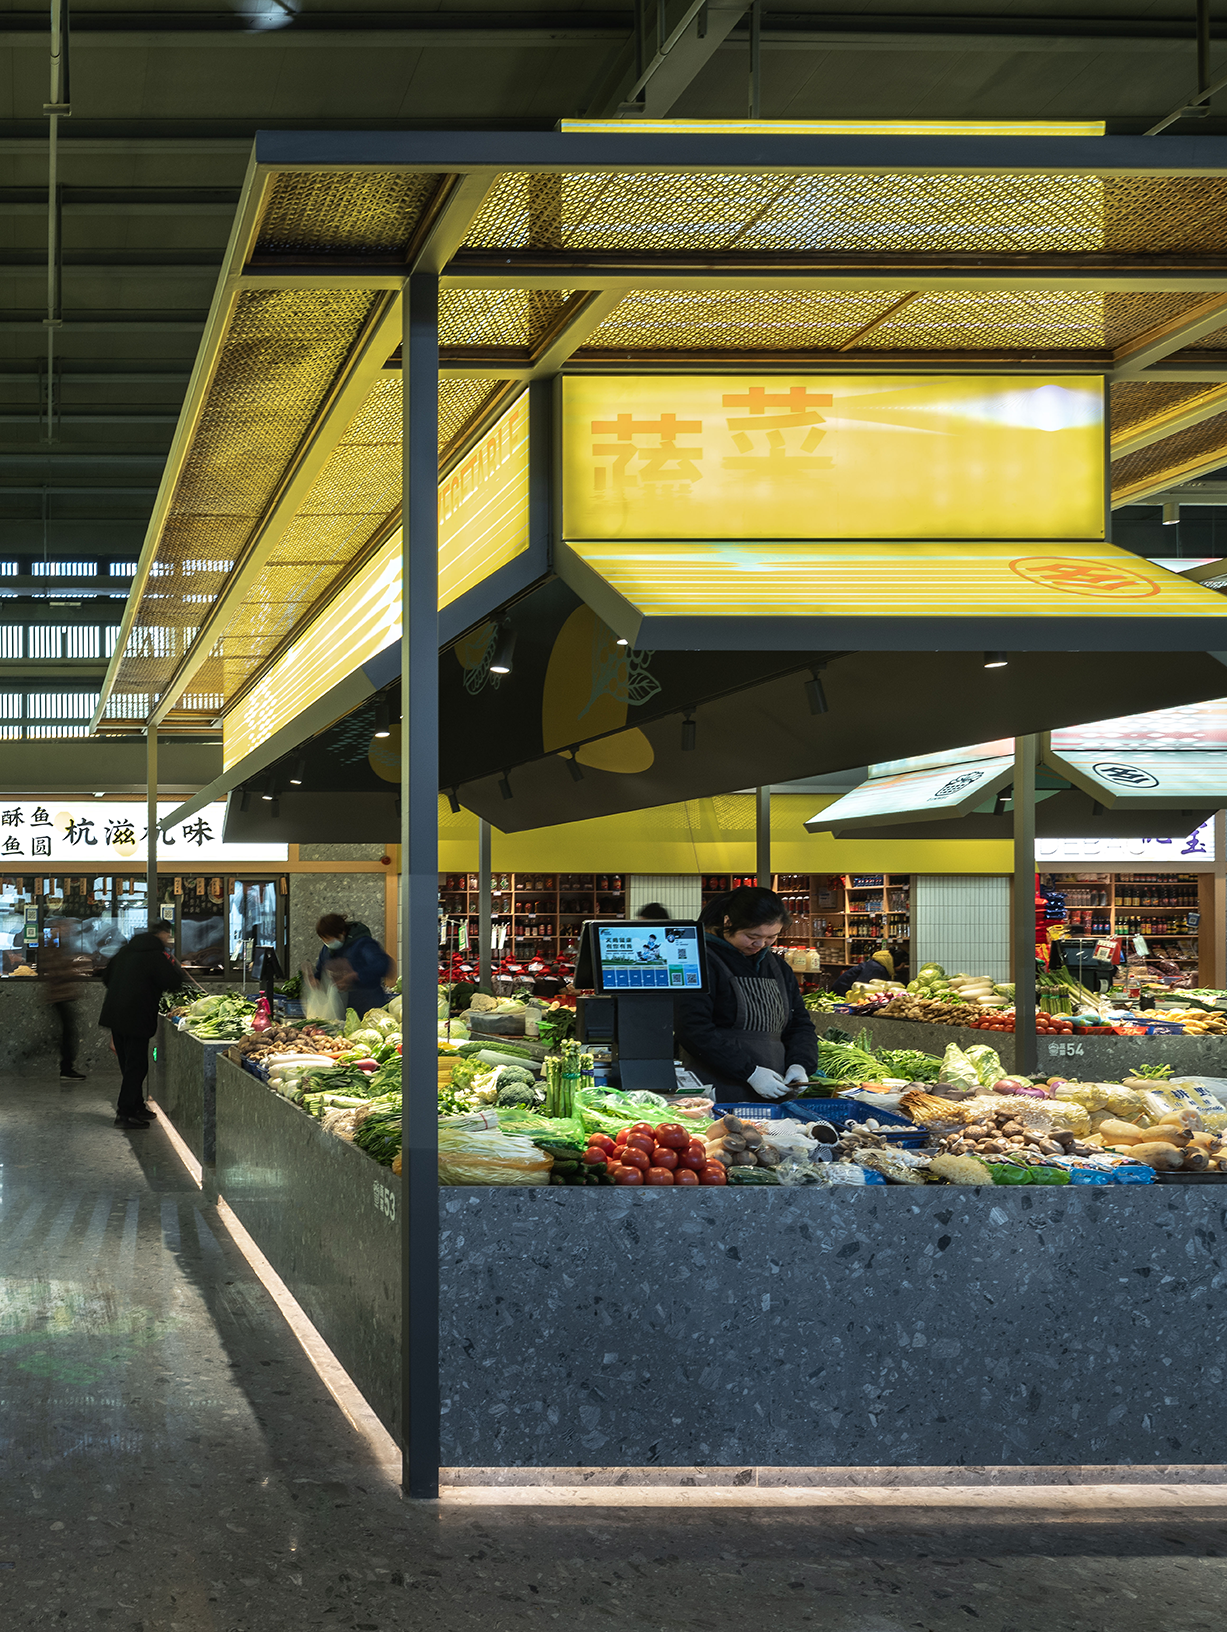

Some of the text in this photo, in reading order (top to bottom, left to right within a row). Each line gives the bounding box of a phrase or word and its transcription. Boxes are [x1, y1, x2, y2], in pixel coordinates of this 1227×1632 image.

[590, 386, 834, 500] 蔬菜
[1066, 1042, 1085, 1057] 54
[384, 1188, 395, 1221] 53
